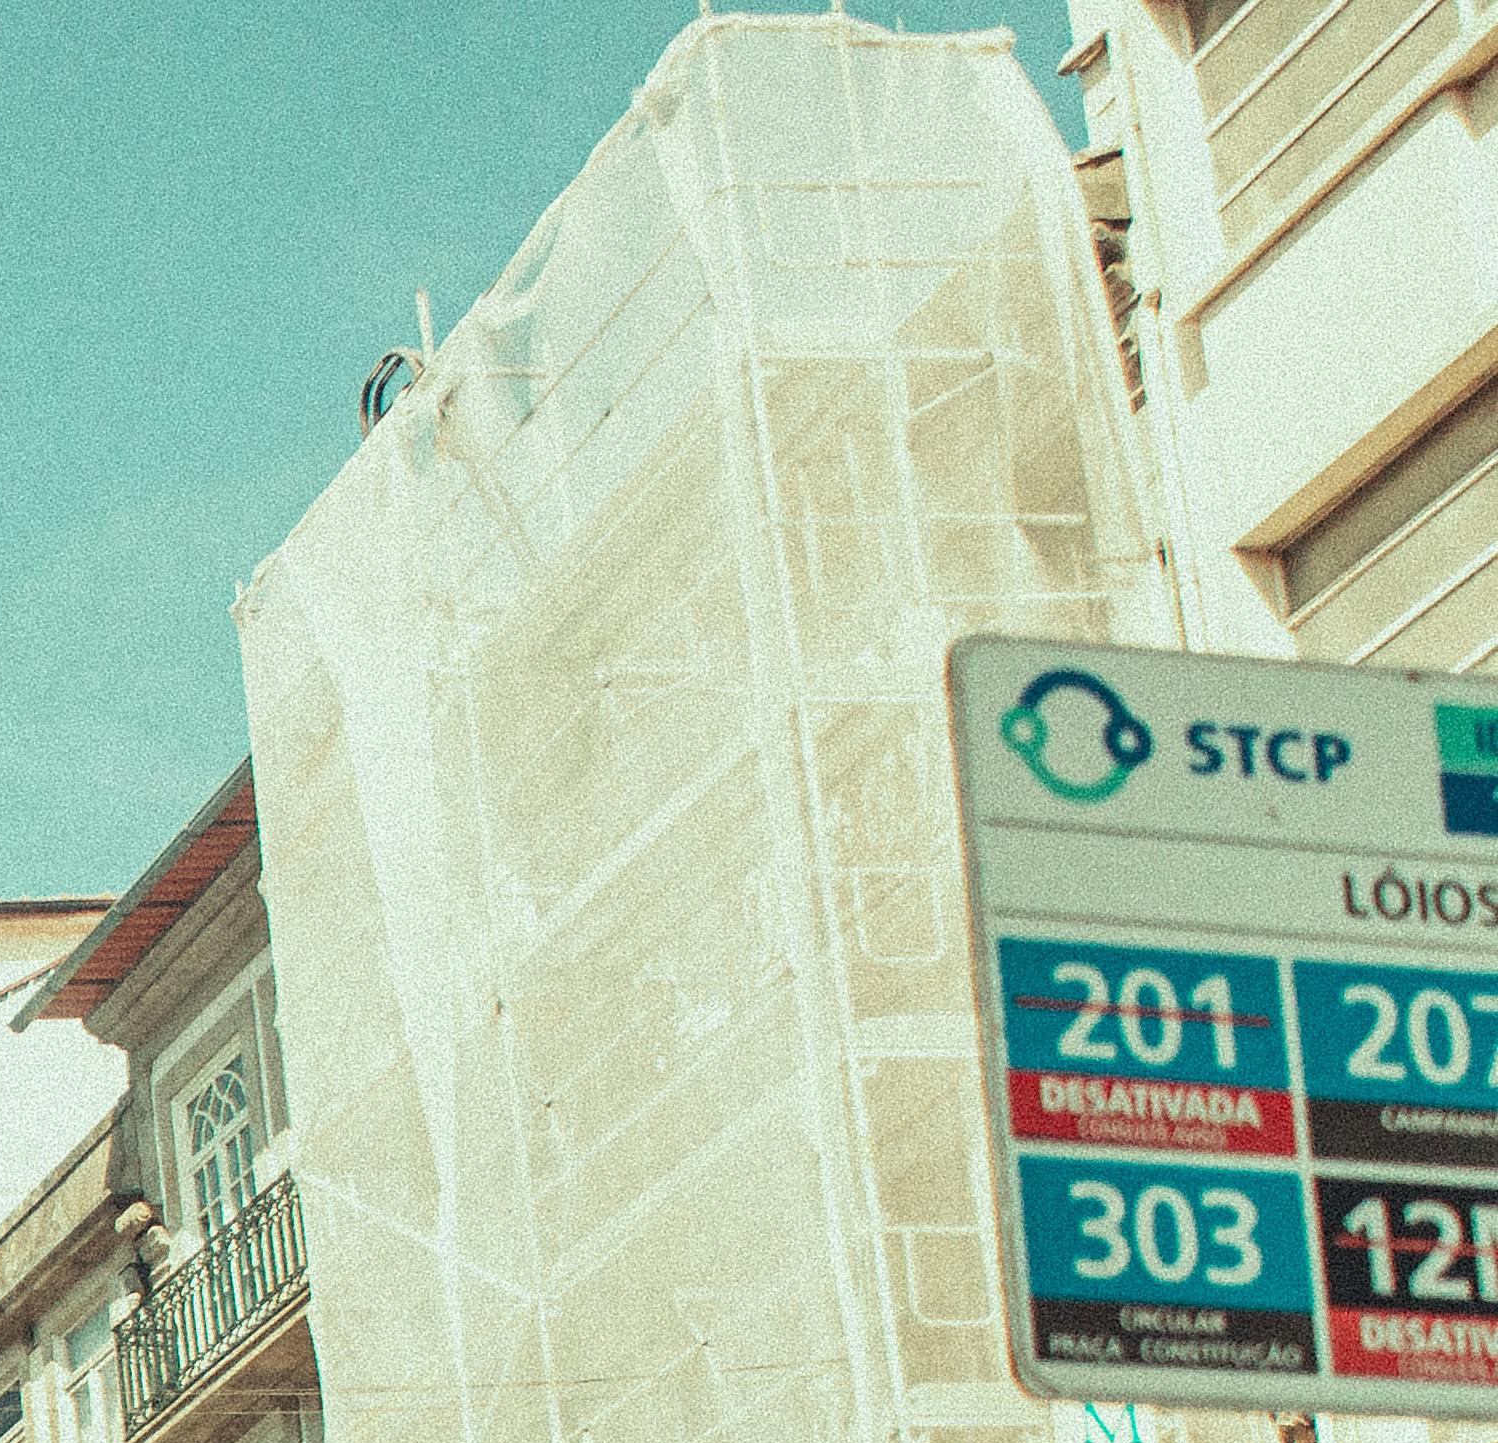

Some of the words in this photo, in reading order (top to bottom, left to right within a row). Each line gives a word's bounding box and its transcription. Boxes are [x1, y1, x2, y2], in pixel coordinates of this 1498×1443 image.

[1185, 720, 1353, 784] STCP
[1342, 864, 1498, 927] LÓIOS
[1053, 962, 1237, 1070] 201
[1040, 1078, 1262, 1131] DESATIVADA
[1069, 1180, 1263, 1286] 303
